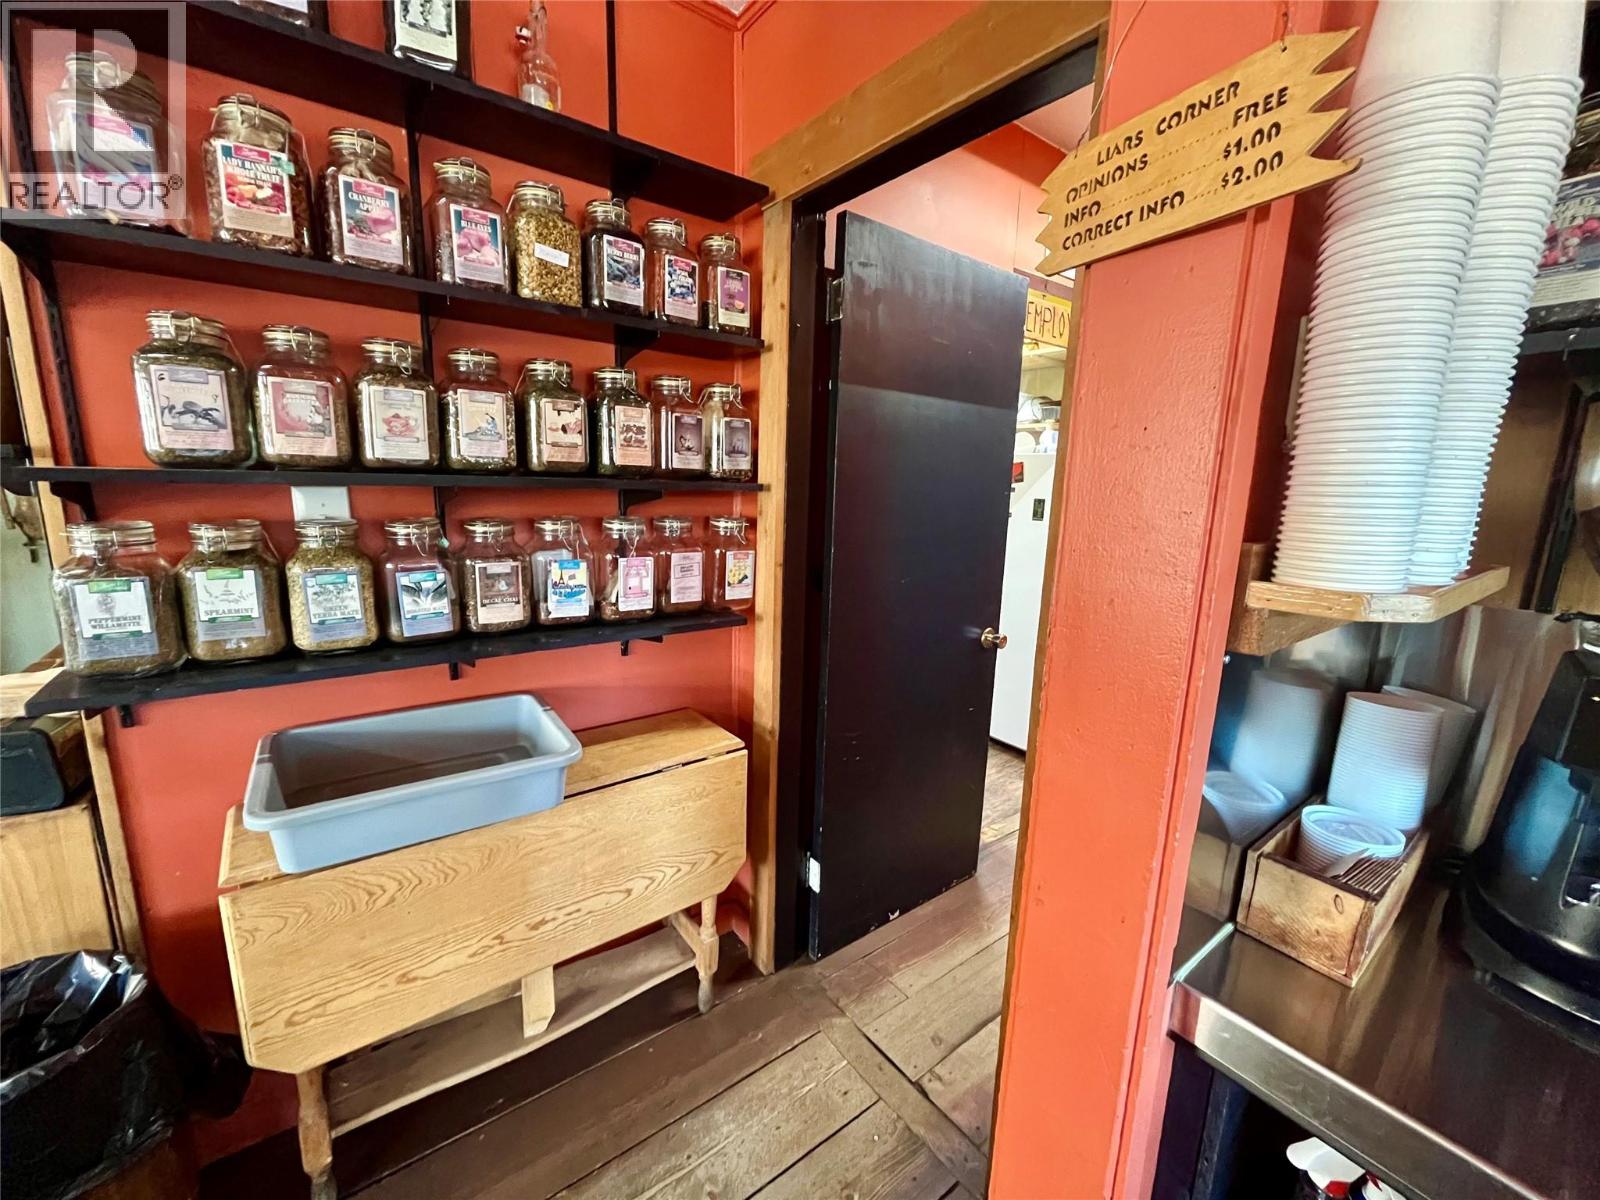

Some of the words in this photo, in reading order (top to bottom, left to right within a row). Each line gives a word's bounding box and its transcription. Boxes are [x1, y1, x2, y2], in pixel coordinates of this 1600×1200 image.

[1066, 152, 1149, 204] OPINIONS
[1231, 86, 1289, 129] FREE
[1096, 130, 1144, 166] LIARS
[1155, 80, 1241, 136] CORNER
[1062, 208, 1132, 251] CORRECT
[1138, 190, 1186, 222] INFO
[1220, 150, 1285, 189] $2.00
[1063, 200, 1102, 228] INFO
[1222, 120, 1282, 160] $1.00
[88, 615, 142, 624] PEPPERMINT
[204, 607, 254, 616] SPEARMINT
